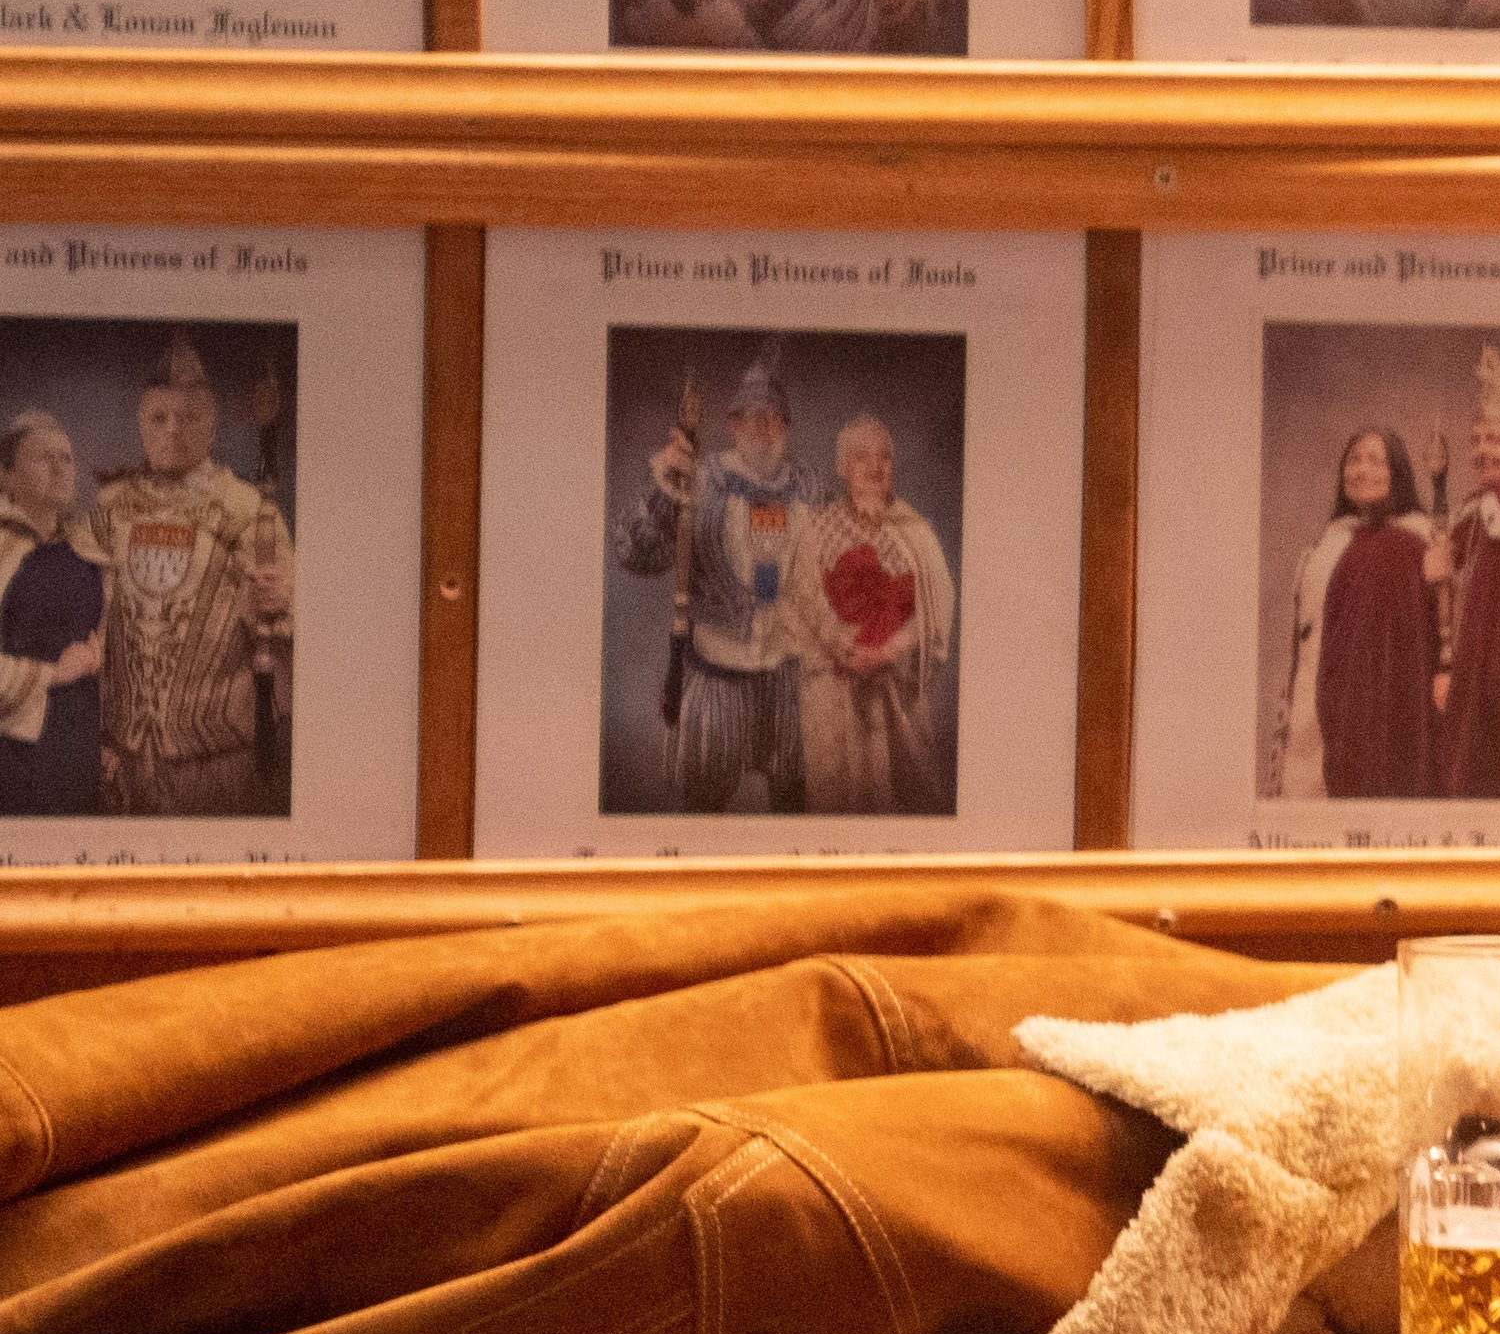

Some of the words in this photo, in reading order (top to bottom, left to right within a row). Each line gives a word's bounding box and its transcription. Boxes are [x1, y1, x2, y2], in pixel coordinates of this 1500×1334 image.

[62, 3, 87, 31] &
[4, 246, 54, 269] and
[62, 239, 184, 277] Princess
[193, 247, 219, 273] of
[230, 243, 309, 275] Fools
[598, 245, 682, 283] Prince
[691, 257, 738, 280] and
[748, 252, 861, 288] Princess
[869, 257, 892, 283] of
[901, 257, 977, 287] Fools
